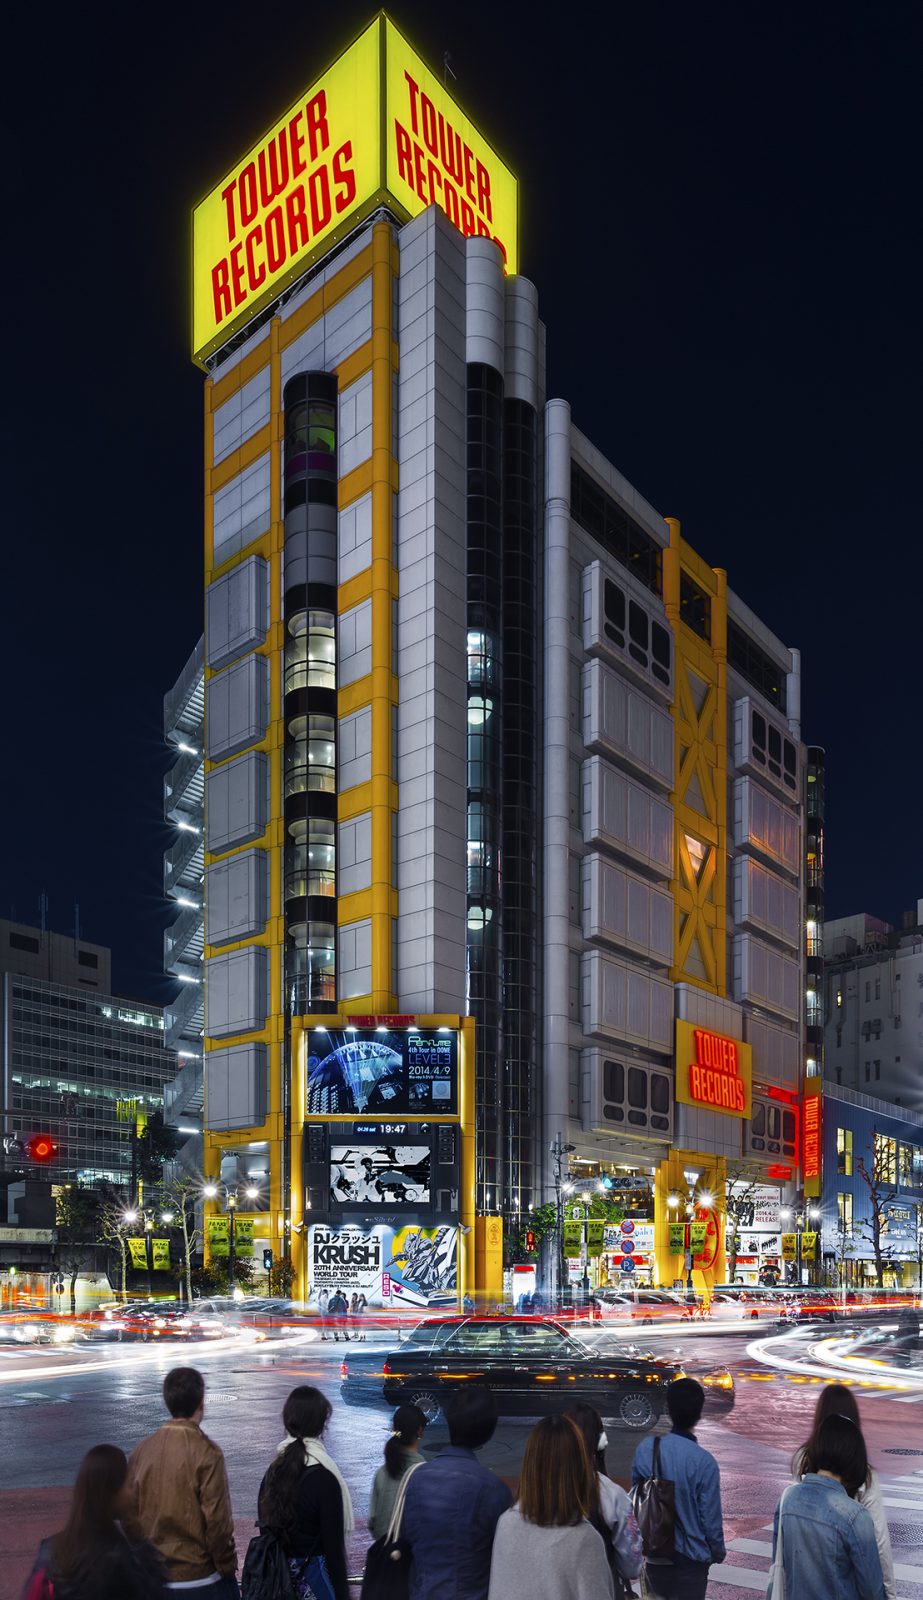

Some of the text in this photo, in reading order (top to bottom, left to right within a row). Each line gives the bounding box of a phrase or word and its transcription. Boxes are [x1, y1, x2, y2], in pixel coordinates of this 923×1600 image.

[221, 89, 330, 243] TOWER
[405, 69, 493, 224] TOWER
[394, 118, 508, 277] RECOR
[211, 140, 357, 325] RECORDS
[408, 1036, 452, 1047] Perfume
[696, 1030, 737, 1075] TOWER
[408, 1066, 451, 1075] 2014/4/9
[691, 1065, 744, 1111] RECORDS
[380, 1124, 406, 1133] 19:47
[805, 1096, 818, 1177] TOWER RECORDS
[313, 1245, 380, 1265] KRUSH
[623, 1261, 630, 1270] P
